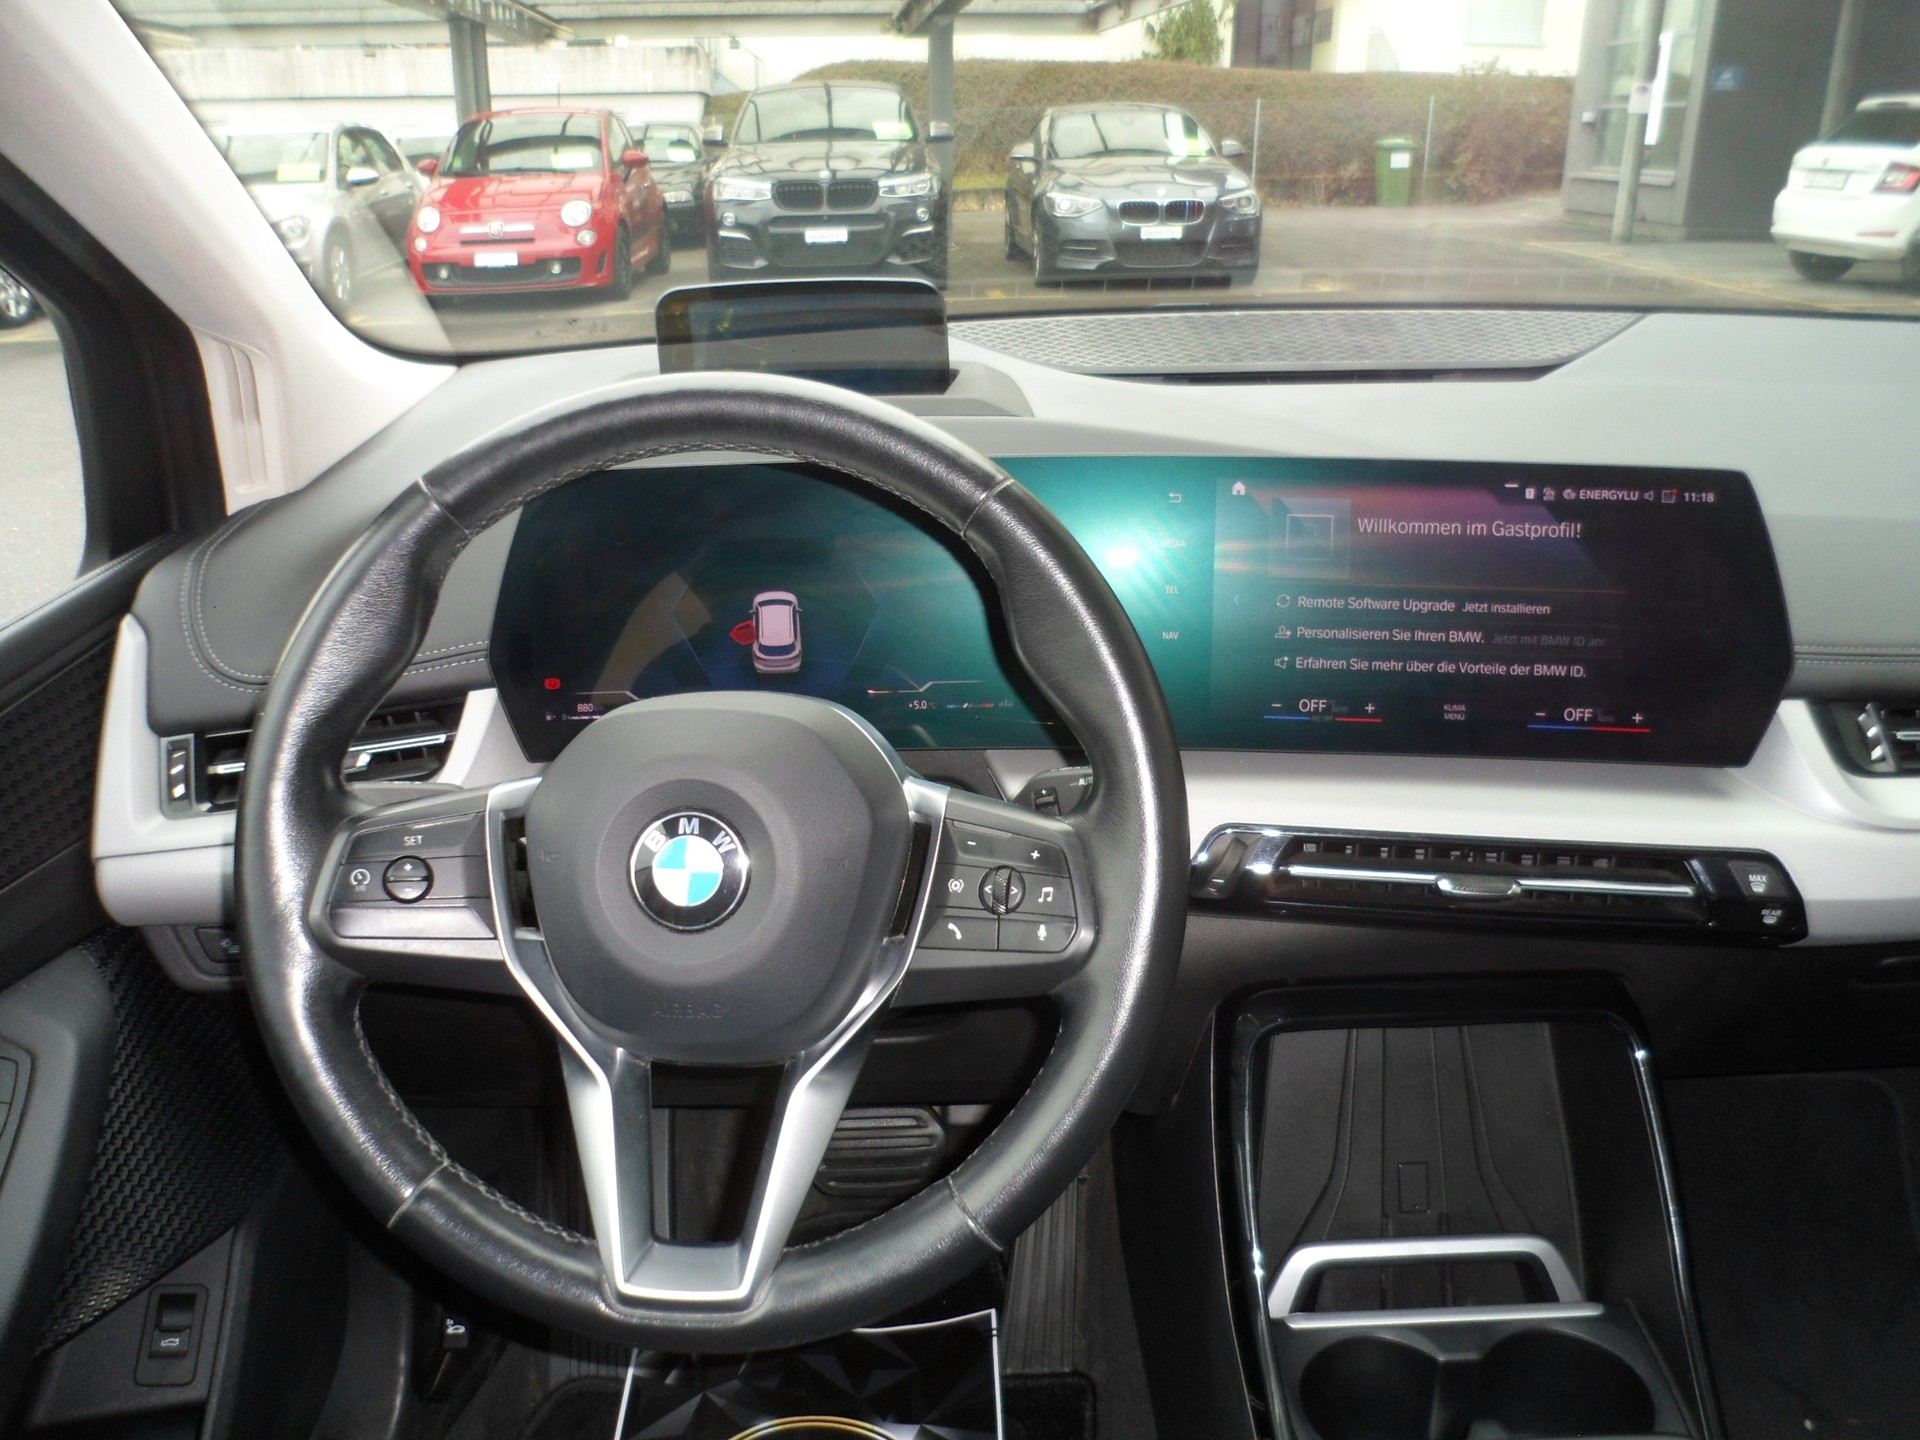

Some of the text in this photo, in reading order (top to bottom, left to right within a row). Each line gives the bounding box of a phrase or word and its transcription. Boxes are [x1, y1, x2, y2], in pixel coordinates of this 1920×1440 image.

[1579, 489, 1638, 500] ENERGYLU
[1683, 492, 1714, 502] 11:18
[1357, 517, 1582, 540] Willkommen im Gastprofil!
[1164, 585, 1179, 594] TEL
[1298, 596, 1551, 615] Remote Software Upgrade Jetzt installieren
[1162, 631, 1179, 640] NAV
[1296, 626, 1389, 641] Personalisieren
[1392, 629, 1412, 641] Sie
[1414, 630, 1446, 642] Ihren
[1449, 631, 1485, 643] BMW.
[1540, 635, 1570, 646] BMW
[1296, 657, 1587, 677] Erfahren Sie mehr über die Vorteile der BMW ID.
[577, 703, 593, 712] 880
[909, 700, 927, 710] +5.0
[1298, 699, 1328, 713] OFF
[1443, 704, 1466, 712] KLIMA
[1563, 708, 1593, 722] OFF
[403, 835, 423, 846] SET
[644, 817, 736, 853] BMW
[1748, 874, 1767, 883] MAX
